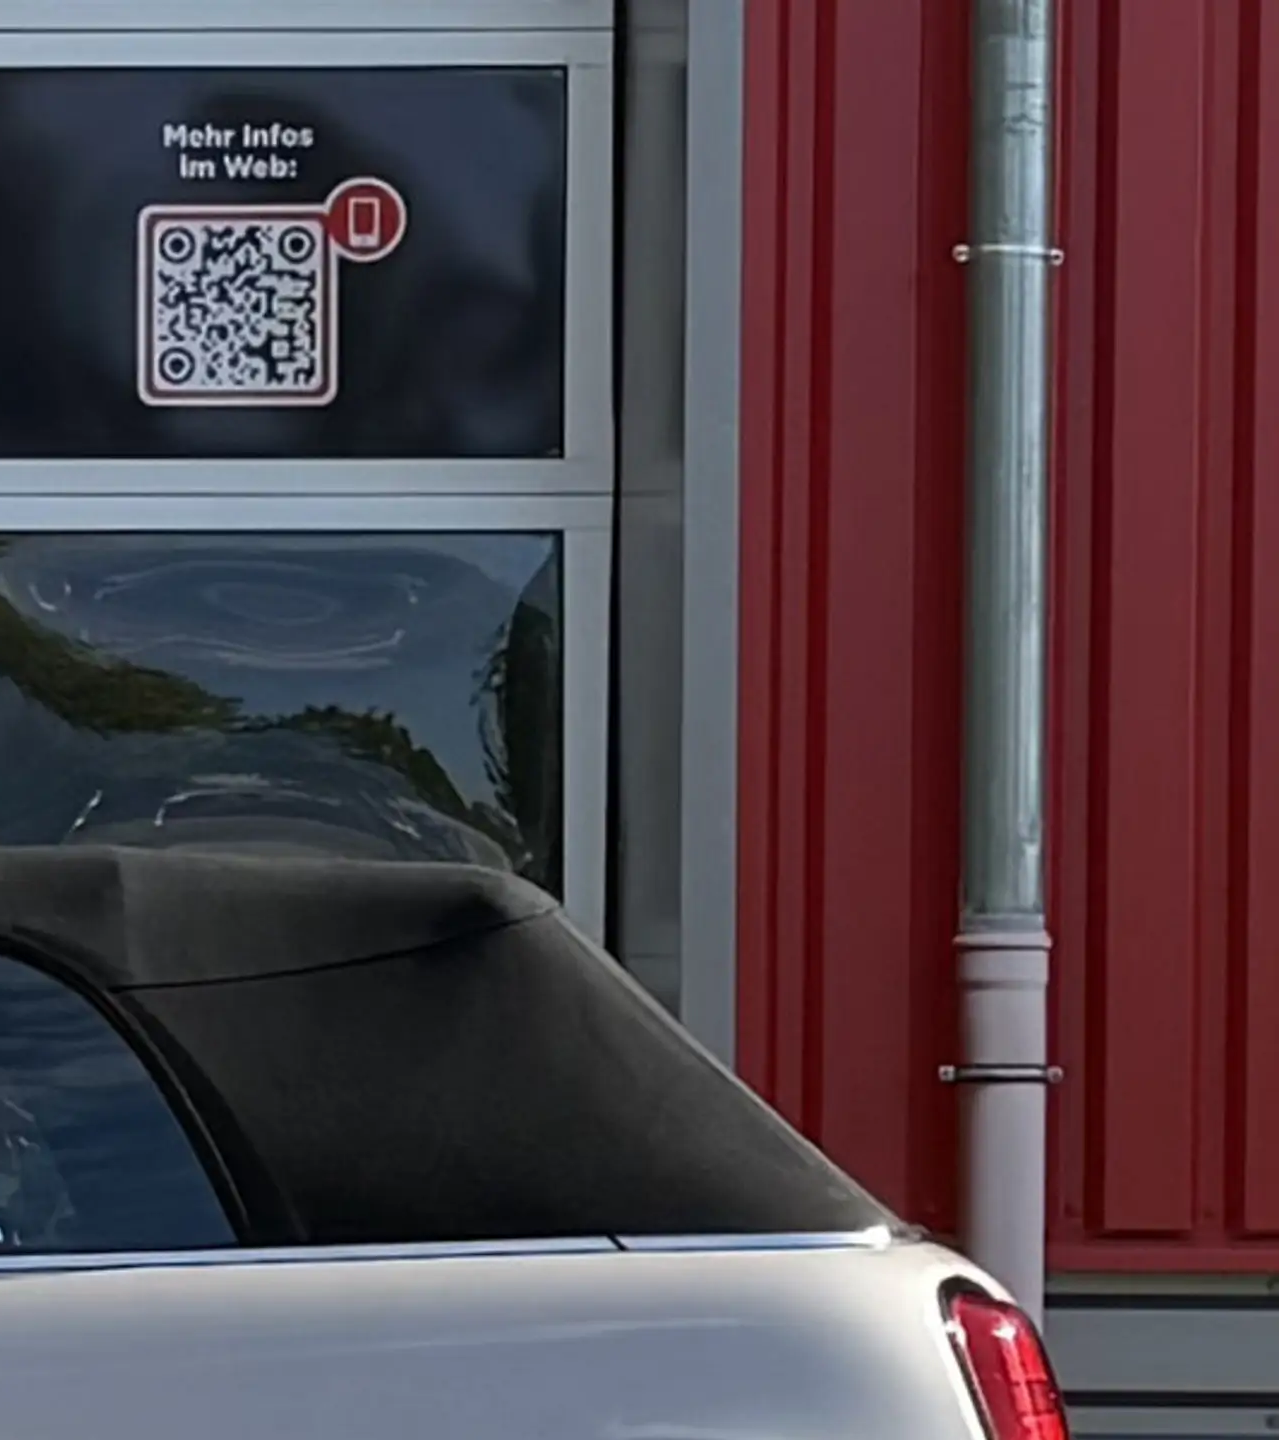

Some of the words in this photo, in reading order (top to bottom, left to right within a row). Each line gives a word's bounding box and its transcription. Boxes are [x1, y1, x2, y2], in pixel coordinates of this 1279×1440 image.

[163, 123, 236, 149] Mehr
[242, 122, 314, 148] Infos
[223, 153, 298, 179] Web:
